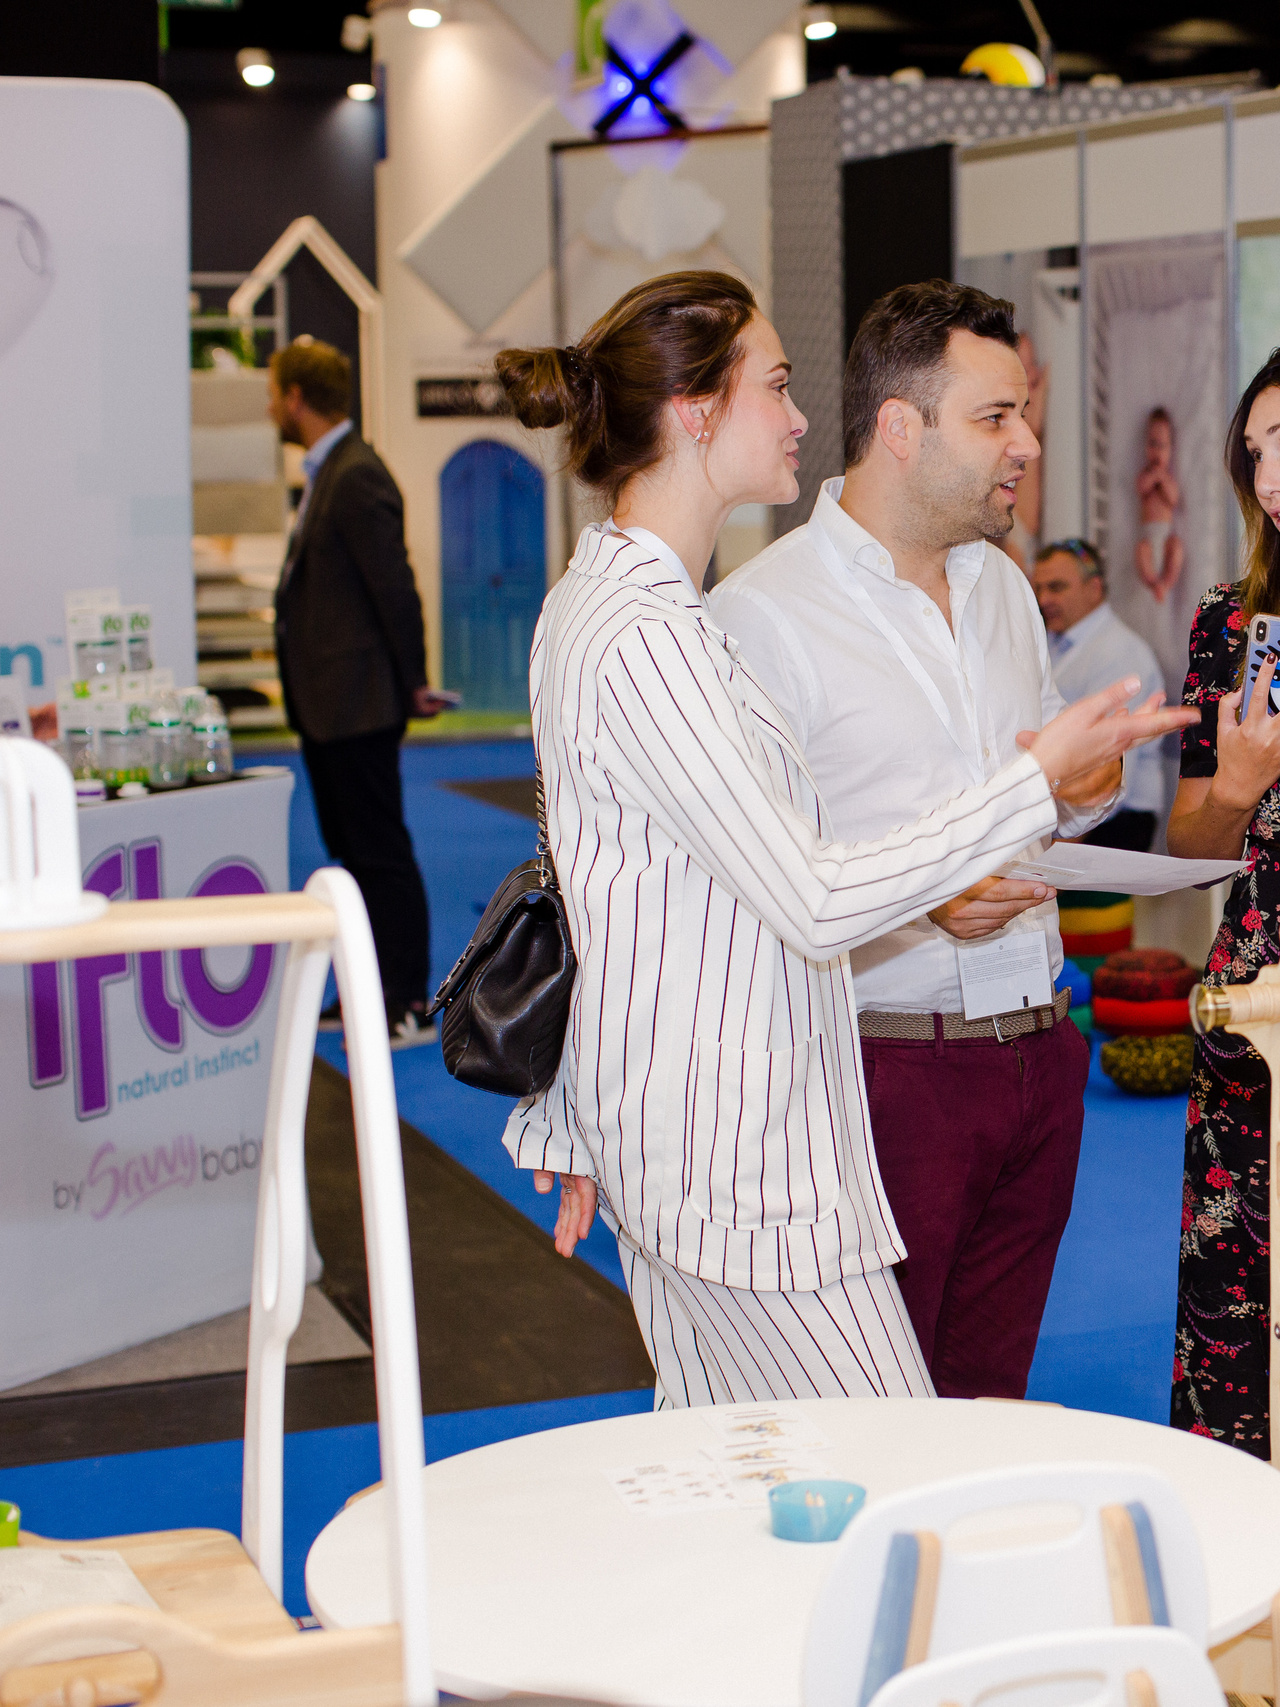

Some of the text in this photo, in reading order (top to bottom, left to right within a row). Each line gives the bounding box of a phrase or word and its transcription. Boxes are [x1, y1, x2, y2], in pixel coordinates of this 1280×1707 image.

[116, 1040, 261, 1102] natural instinct
[53, 1179, 85, 1212] by
[200, 1131, 264, 1182] bab
